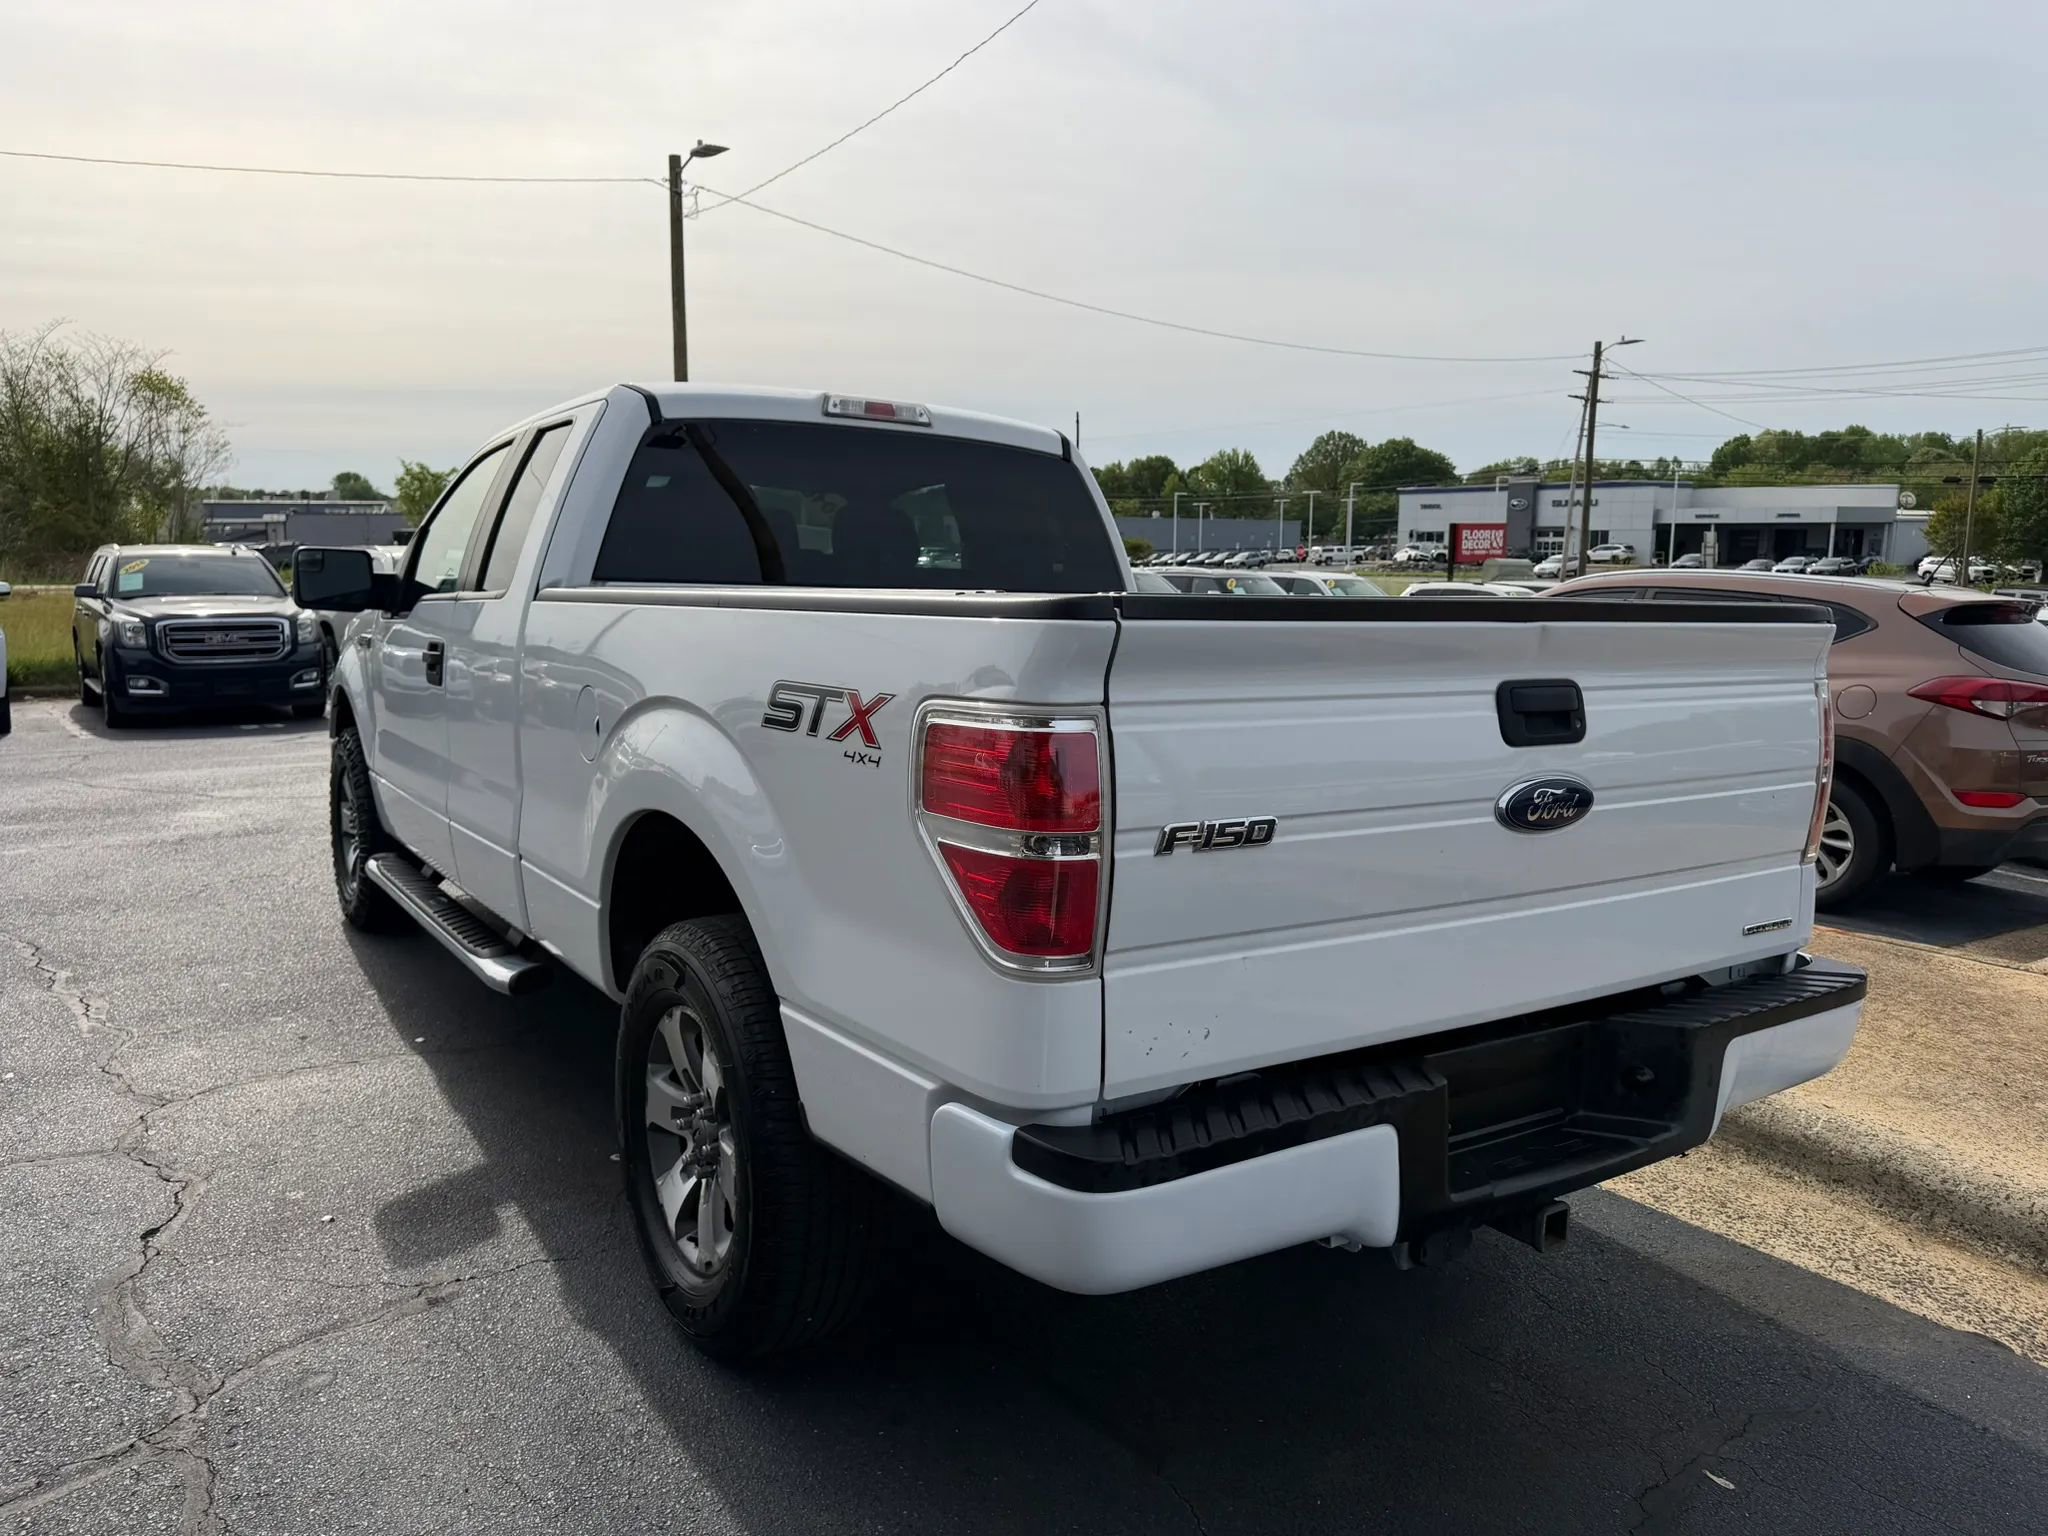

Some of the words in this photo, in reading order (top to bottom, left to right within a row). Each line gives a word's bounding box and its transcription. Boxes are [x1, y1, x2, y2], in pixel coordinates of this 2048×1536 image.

[1551, 499, 1599, 508] SUAU
[1462, 529, 1491, 540] FLOOR
[1462, 539, 1491, 549] DECOR
[761, 679, 897, 750] STX
[1527, 787, 1580, 821] Ford
[1153, 815, 1279, 857] F-150
